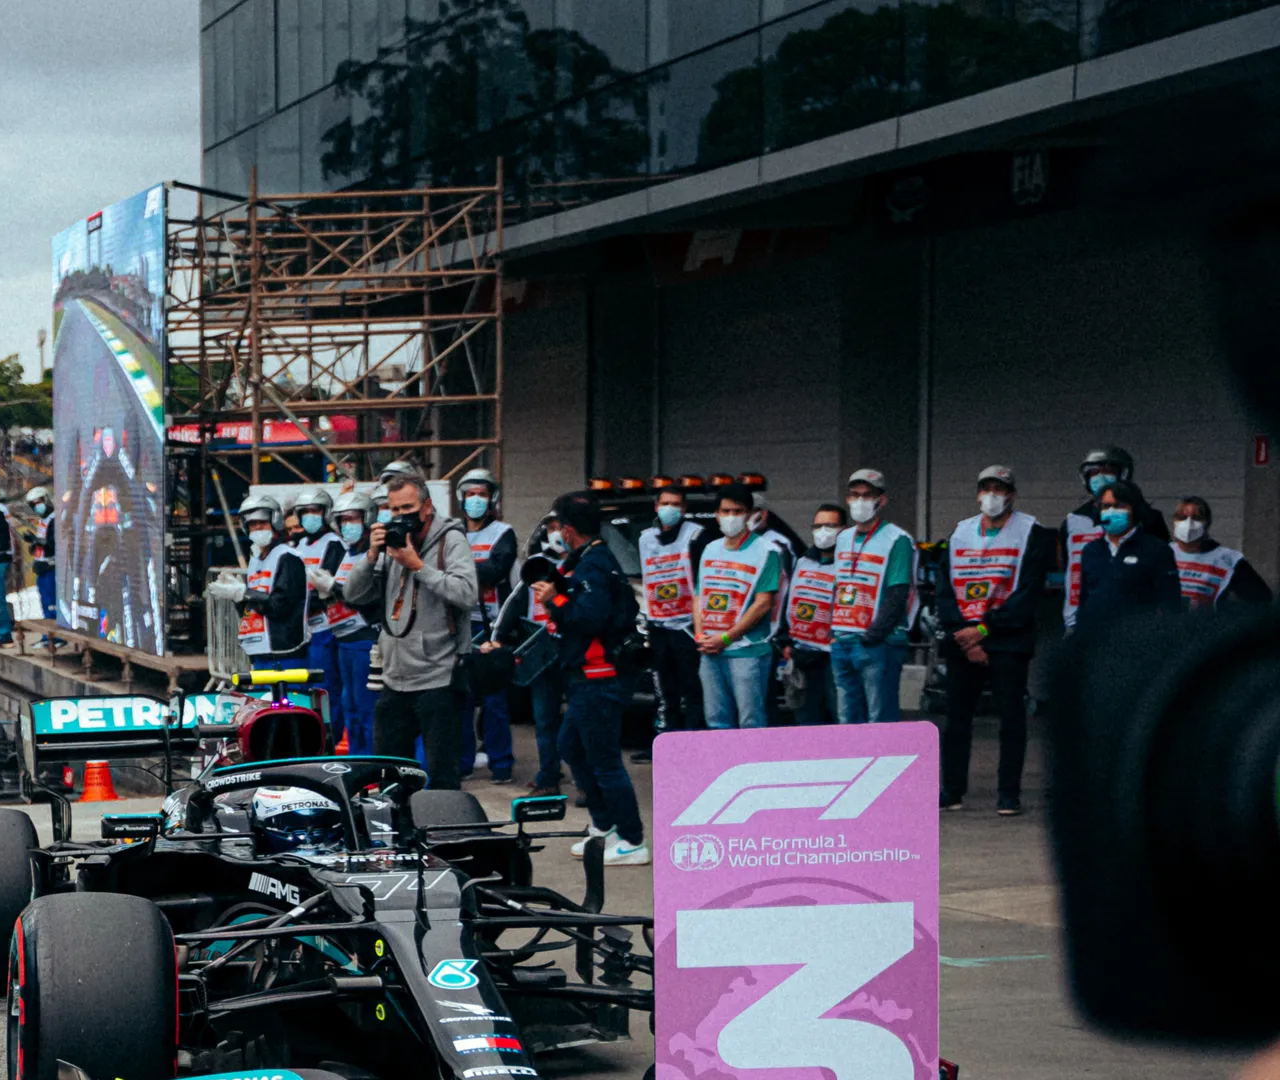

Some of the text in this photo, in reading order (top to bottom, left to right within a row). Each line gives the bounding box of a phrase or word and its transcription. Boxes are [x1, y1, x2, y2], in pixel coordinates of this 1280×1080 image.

[207, 771, 262, 789] CROWDSTRIKE
[281, 800, 330, 811] PETRONAS
[728, 834, 847, 852] FIA Formula 1
[674, 842, 721, 864] FIA
[728, 853, 781, 868] World
[266, 876, 300, 906] AMG
[438, 1015, 513, 1023] CROWDSTRIKE
[462, 1065, 538, 1079] PIRELLI
